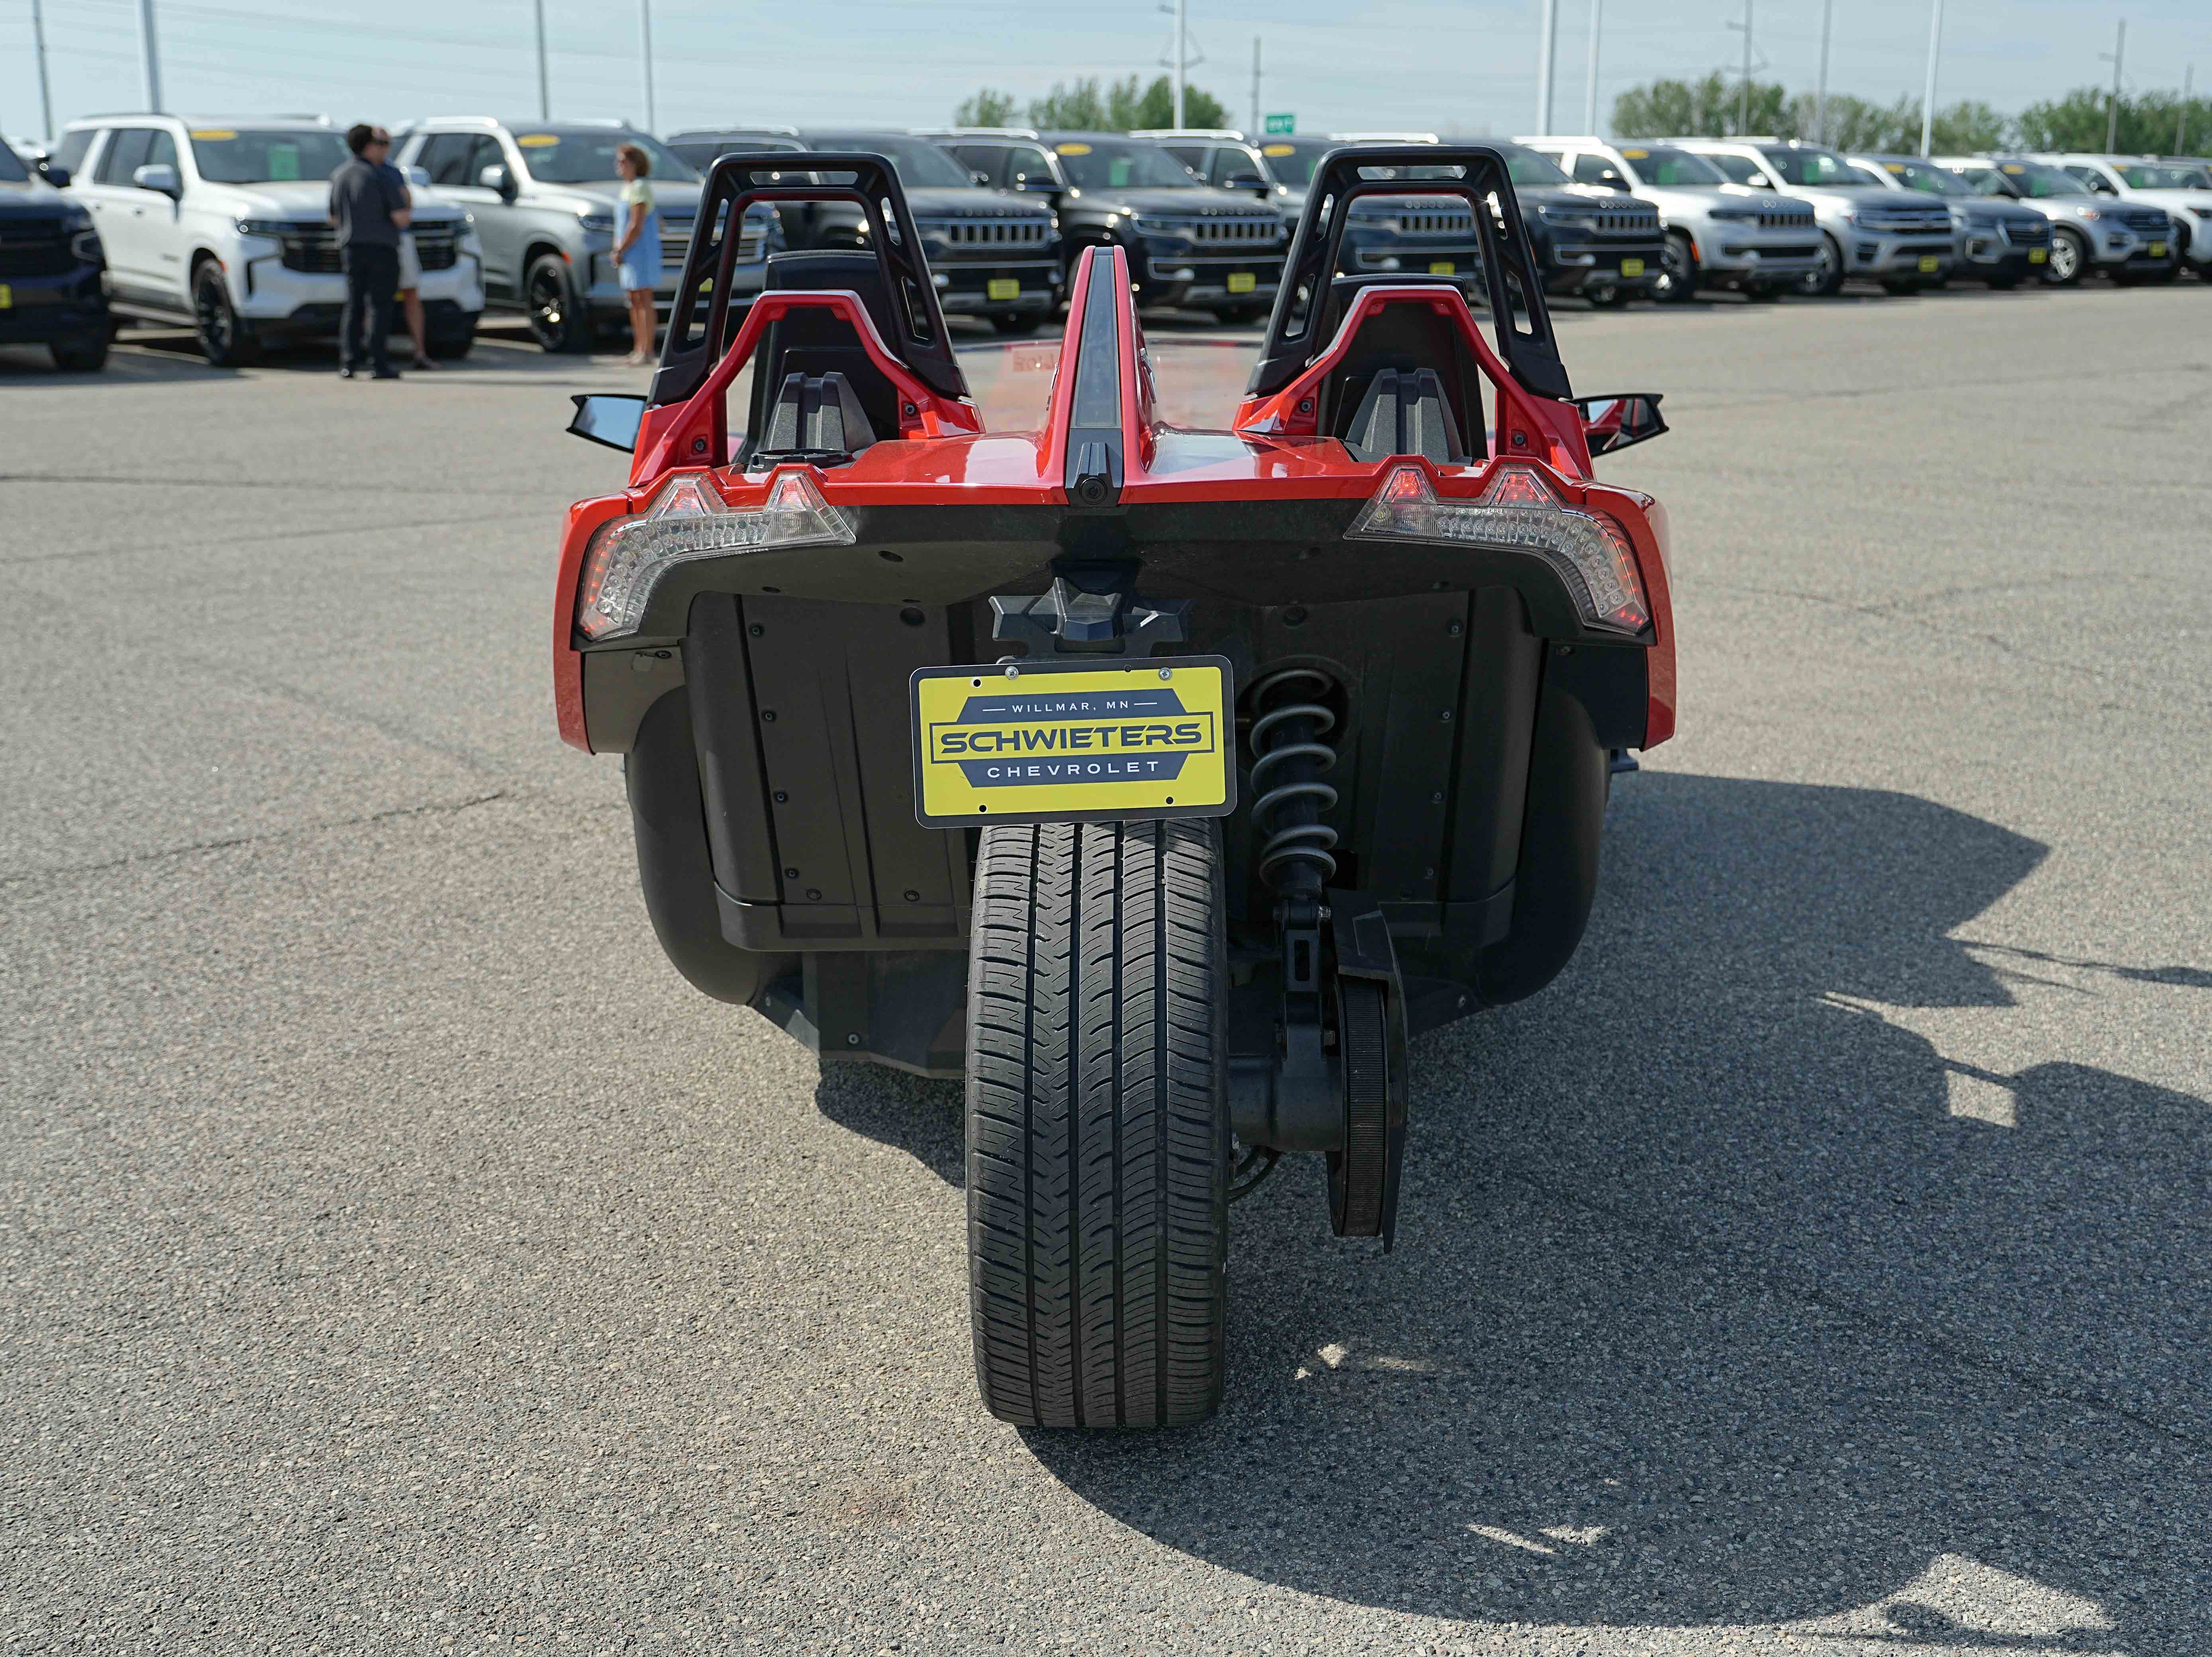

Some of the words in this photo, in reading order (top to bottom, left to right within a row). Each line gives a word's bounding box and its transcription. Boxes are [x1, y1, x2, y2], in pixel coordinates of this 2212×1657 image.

[1012, 702, 1097, 713] WILLMAR,
[1107, 700, 1130, 709] MN
[941, 723, 1202, 754] SCHWIETERS
[987, 761, 1159, 778] CHEVROLET
